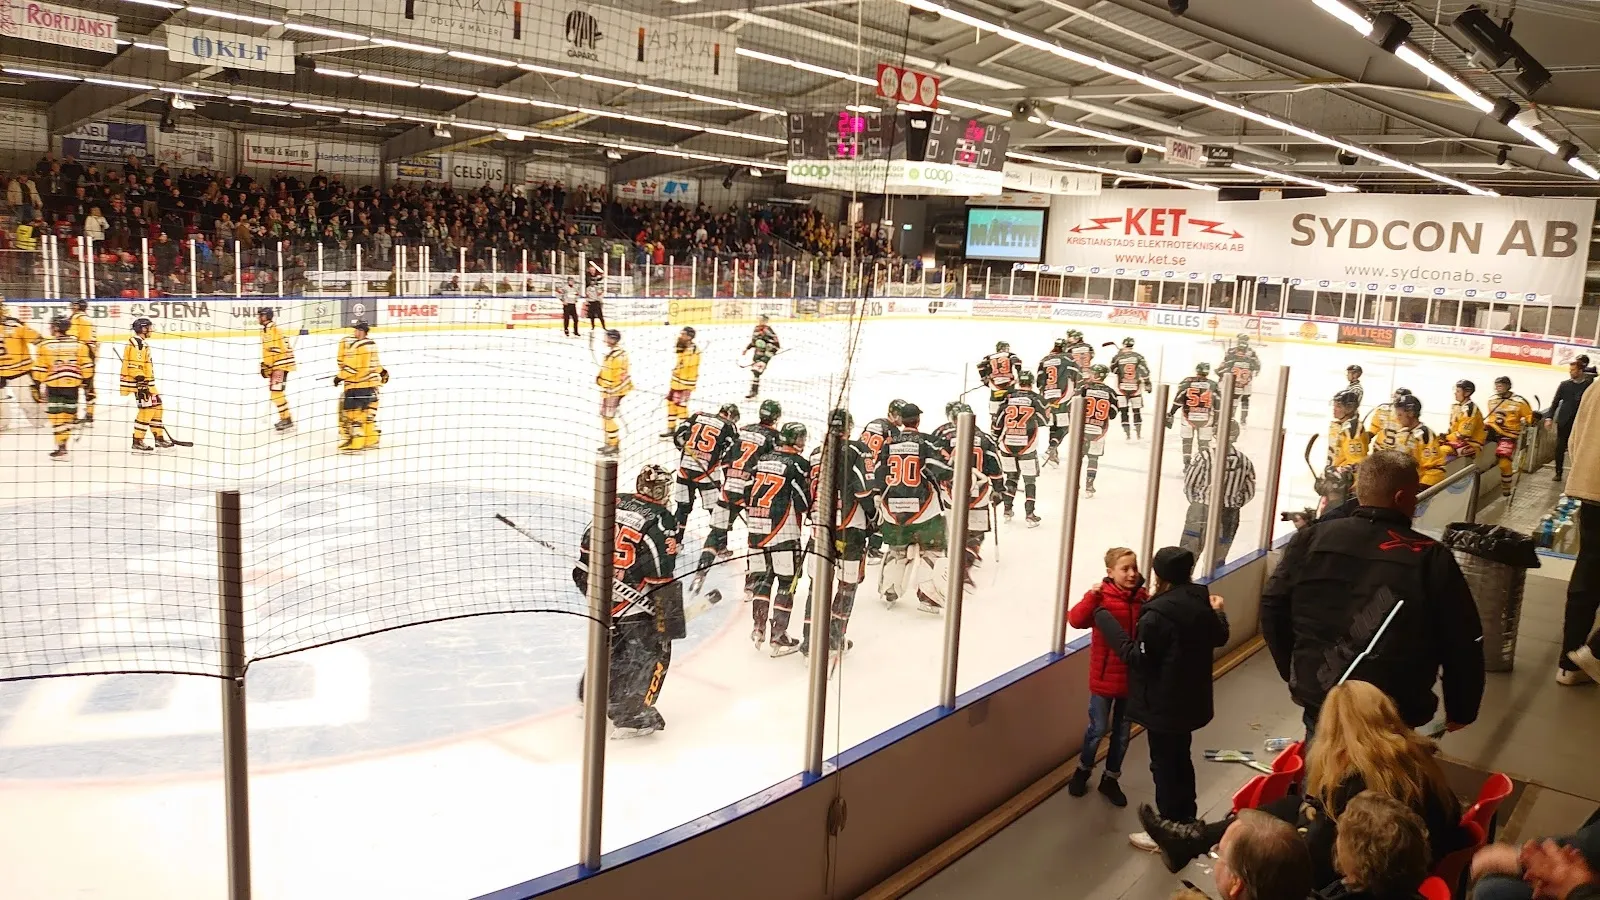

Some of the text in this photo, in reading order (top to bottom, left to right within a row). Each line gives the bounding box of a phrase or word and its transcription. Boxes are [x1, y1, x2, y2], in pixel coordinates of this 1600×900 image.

[649, 29, 711, 57] ARKA
[567, 50, 599, 62] CAPAROL
[453, 160, 503, 182] CELSIUS
[791, 163, 831, 180] coop
[924, 167, 954, 185] coop
[1124, 207, 1188, 237] KET
[1066, 236, 1245, 252] KRISTIANSTADS ELEKTROTEKNISKA AB
[1290, 213, 1578, 258] SYDCON AB
[1115, 252, 1187, 266] www.ket.se
[1344, 265, 1503, 284] www.sydconab.se
[32, 305, 109, 319] PEB
[149, 301, 211, 318] STENA
[232, 306, 283, 318] UNIT
[388, 304, 439, 317] THAGE
[1157, 313, 1201, 327] LELLES
[1342, 325, 1393, 340] WALTERS
[1046, 365, 1058, 385] 3
[1186, 387, 1213, 408] 54
[1004, 405, 1035, 429] 27
[686, 422, 722, 453] 15
[731, 440, 759, 470] 7
[885, 455, 922, 488] 30
[749, 471, 787, 508] 77
[613, 525, 643, 570] 5
